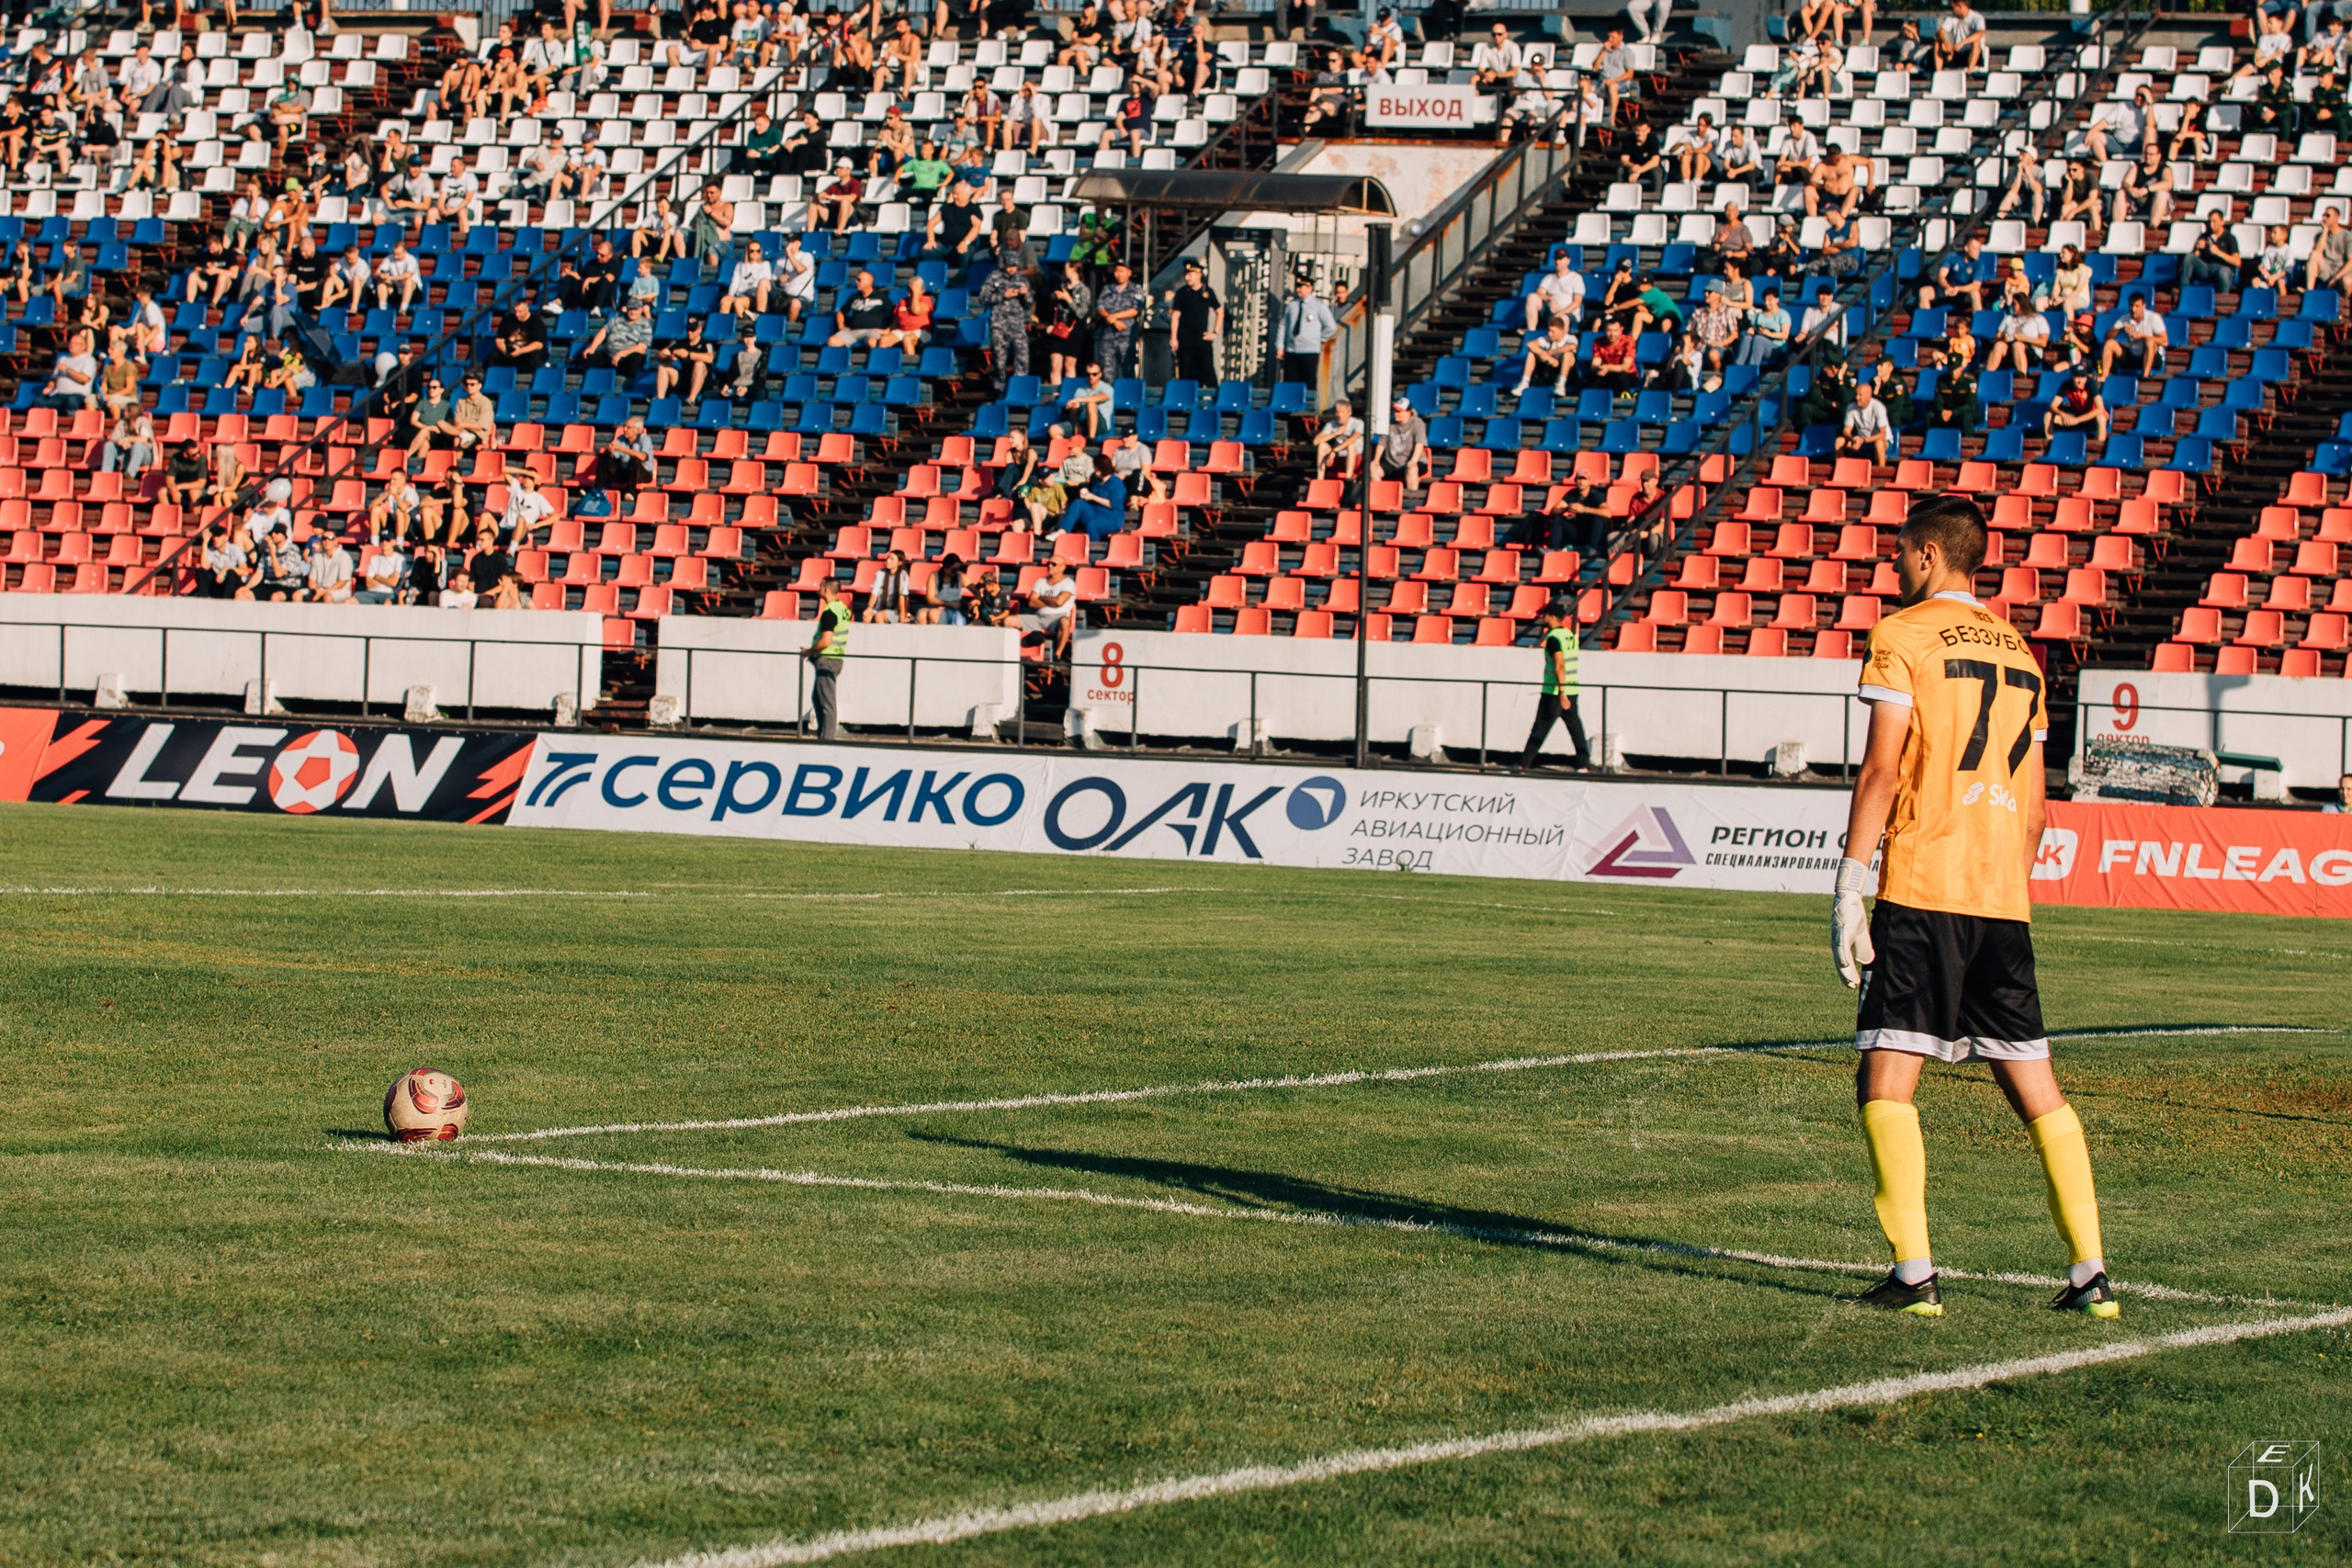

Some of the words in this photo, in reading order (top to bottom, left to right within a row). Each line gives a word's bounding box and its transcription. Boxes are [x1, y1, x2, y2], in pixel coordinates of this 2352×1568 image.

[1380, 98, 1463, 120] ВЫХОД
[1101, 642, 1124, 688] 8
[1087, 689, 1136, 705] сектор
[2112, 683, 2139, 731] 9
[1944, 659, 2041, 779] 77
[105, 723, 466, 813] LEON
[601, 756, 1025, 827] сервико
[1360, 790, 1516, 815] ИРКУТСКИЙ
[1044, 776, 1286, 859] ОАК
[1351, 819, 1565, 846] АВИАЦИОННЫЙ
[1711, 826, 1827, 849] РЕГИОН
[1341, 847, 1433, 871] ЗАВОД
[1705, 853, 1838, 871] СПЕЦИАЛИЗИРОВАНН
[2098, 840, 2352, 886] FNLEAG
